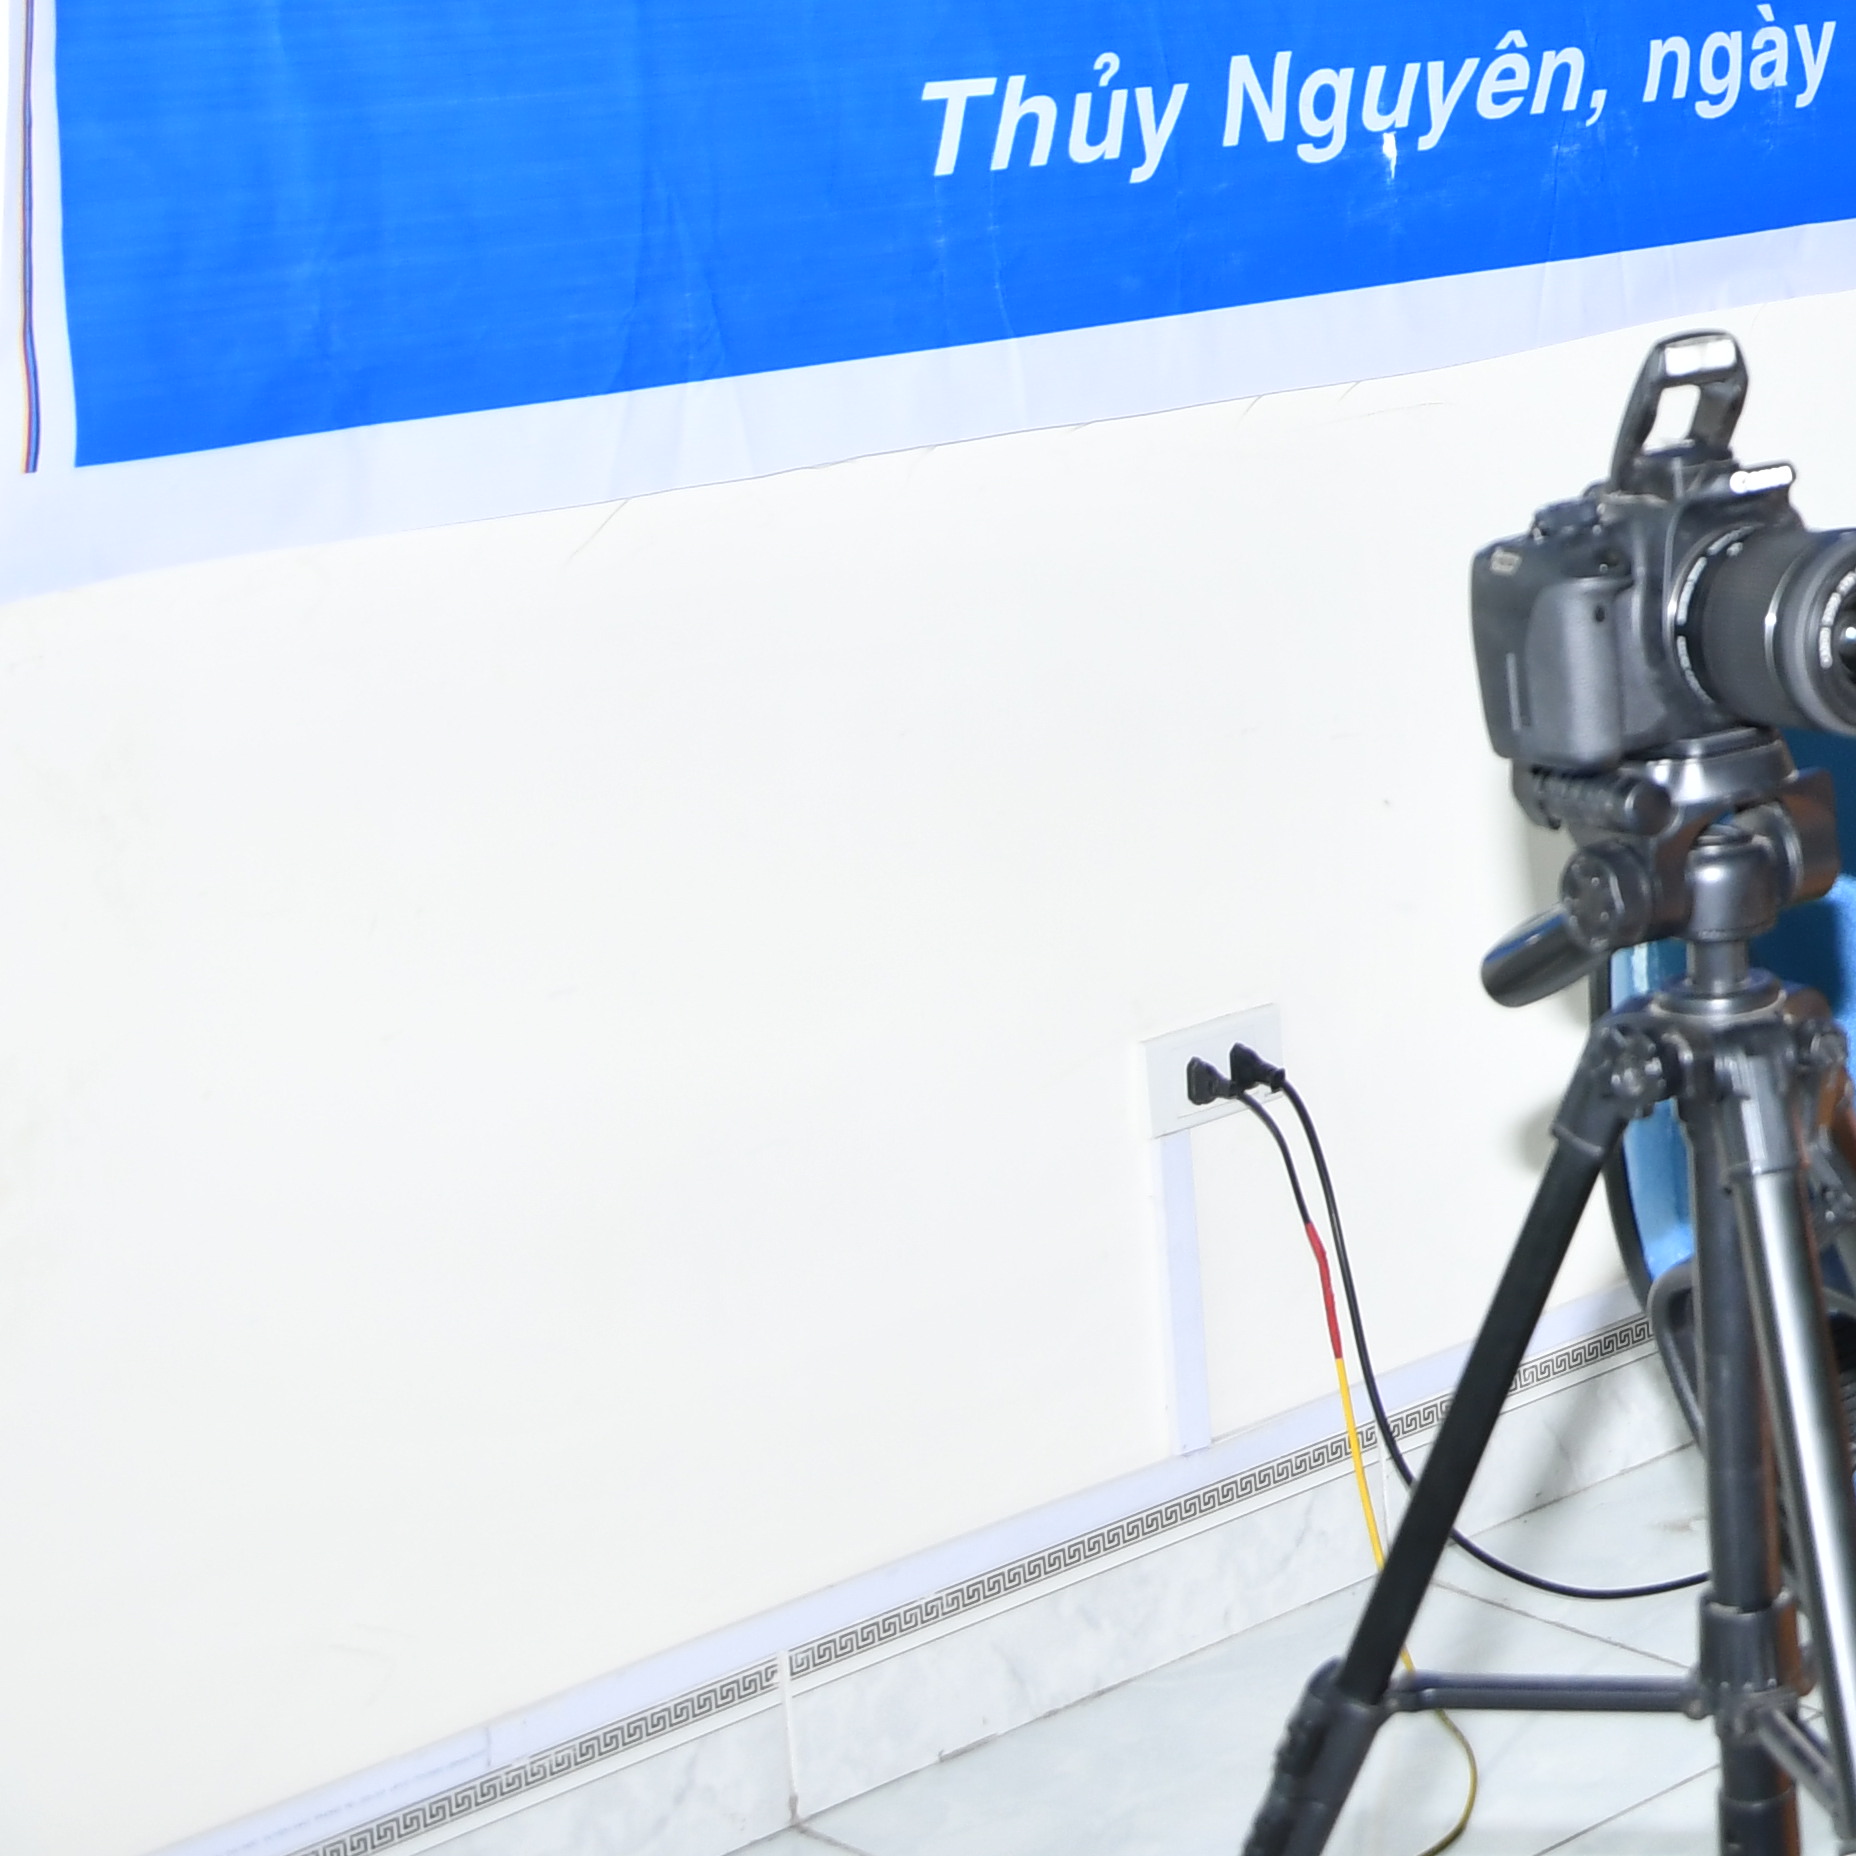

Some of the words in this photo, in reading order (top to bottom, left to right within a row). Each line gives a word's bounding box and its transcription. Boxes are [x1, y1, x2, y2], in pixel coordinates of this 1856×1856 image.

[920, 51, 1190, 185] Thủy
[1221, 28, 1608, 165] Nguyên,
[1641, 2, 1837, 120] ngày
